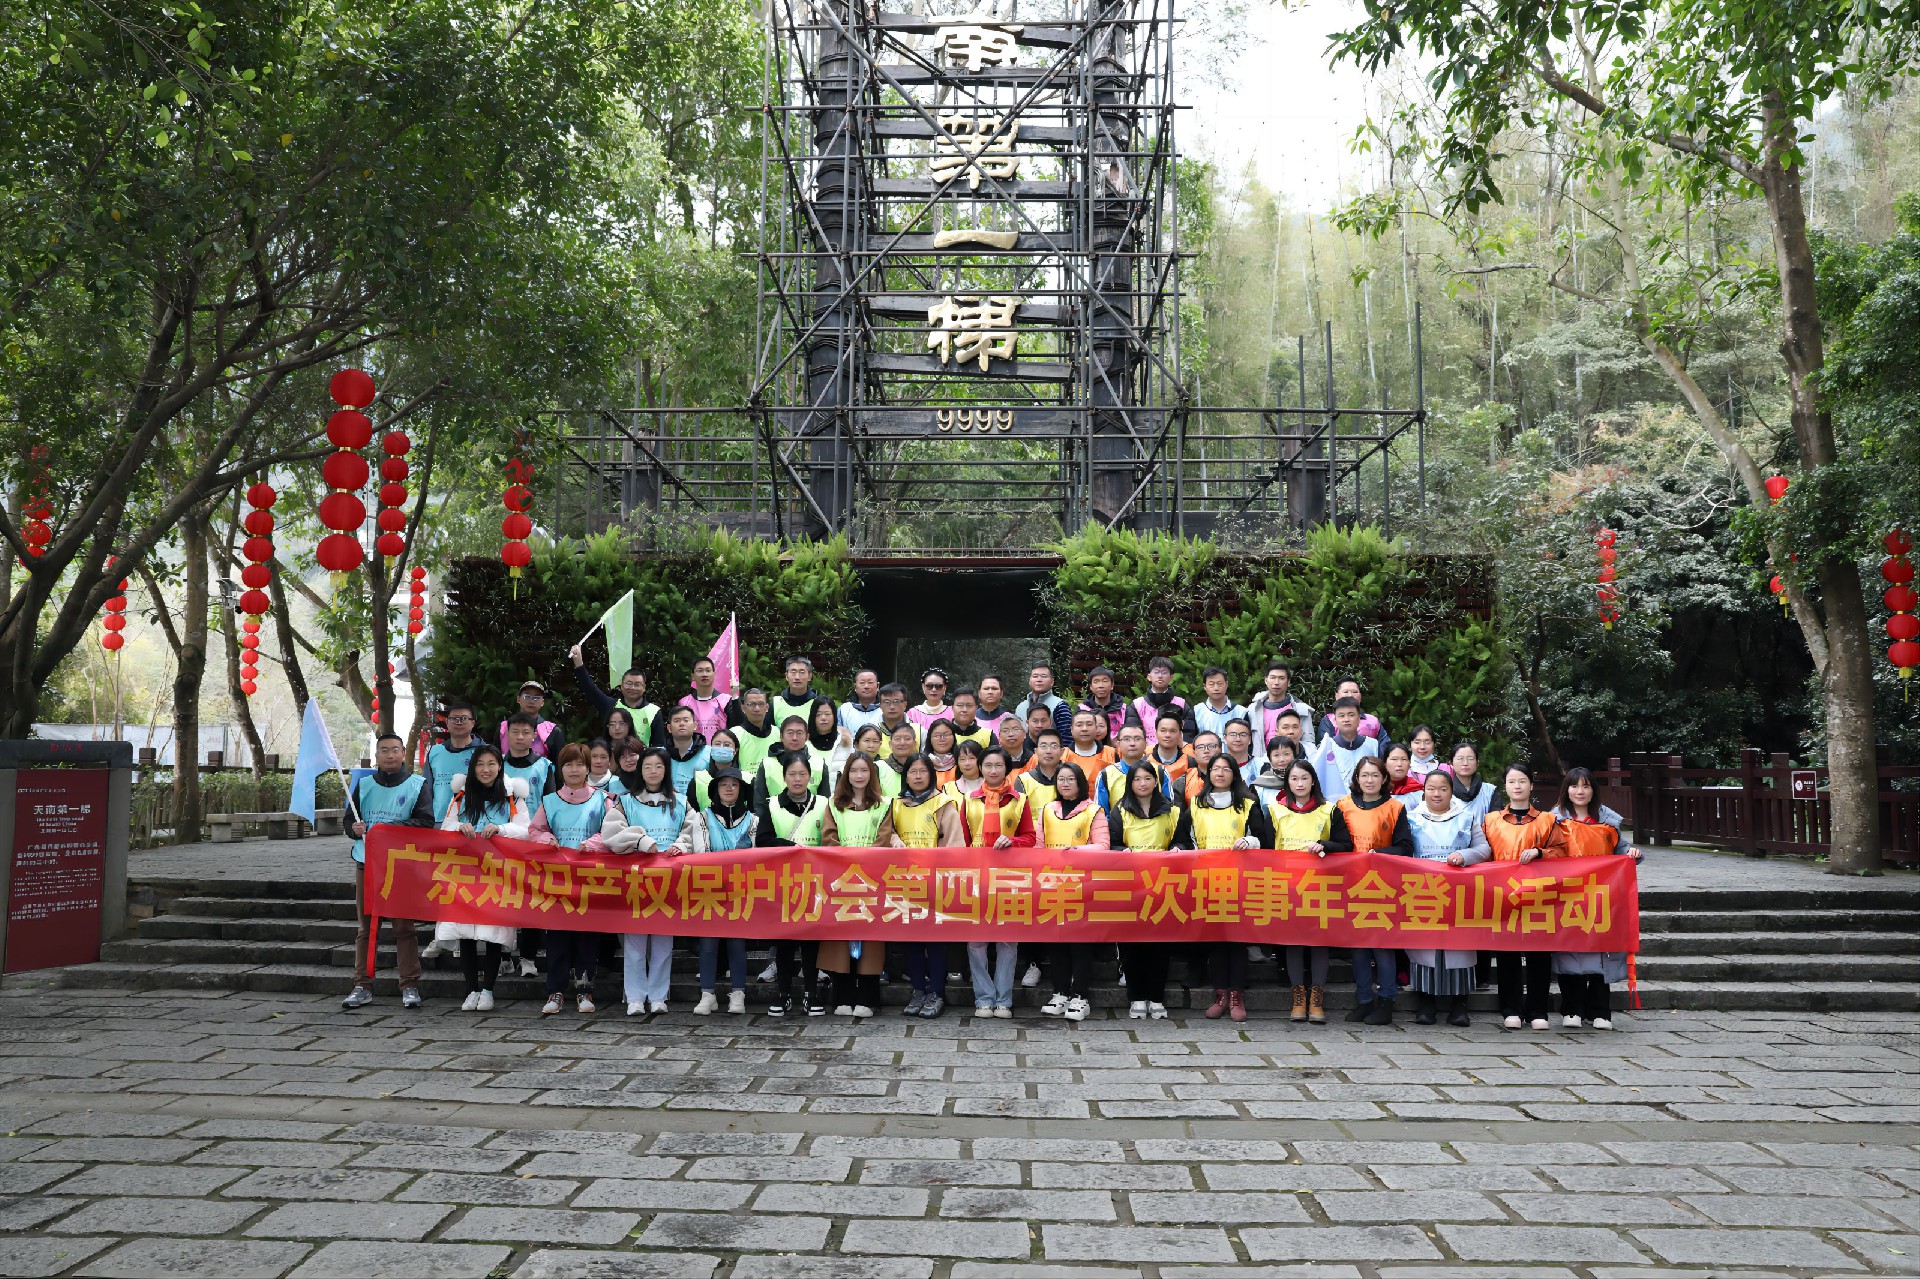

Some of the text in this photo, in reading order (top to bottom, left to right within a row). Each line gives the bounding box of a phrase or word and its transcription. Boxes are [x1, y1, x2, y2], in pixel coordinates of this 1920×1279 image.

[937, 409, 1014, 431] 9999
[380, 843, 1611, 934] 广东知识产权保护协会第四届第三次理事年会登山活动
